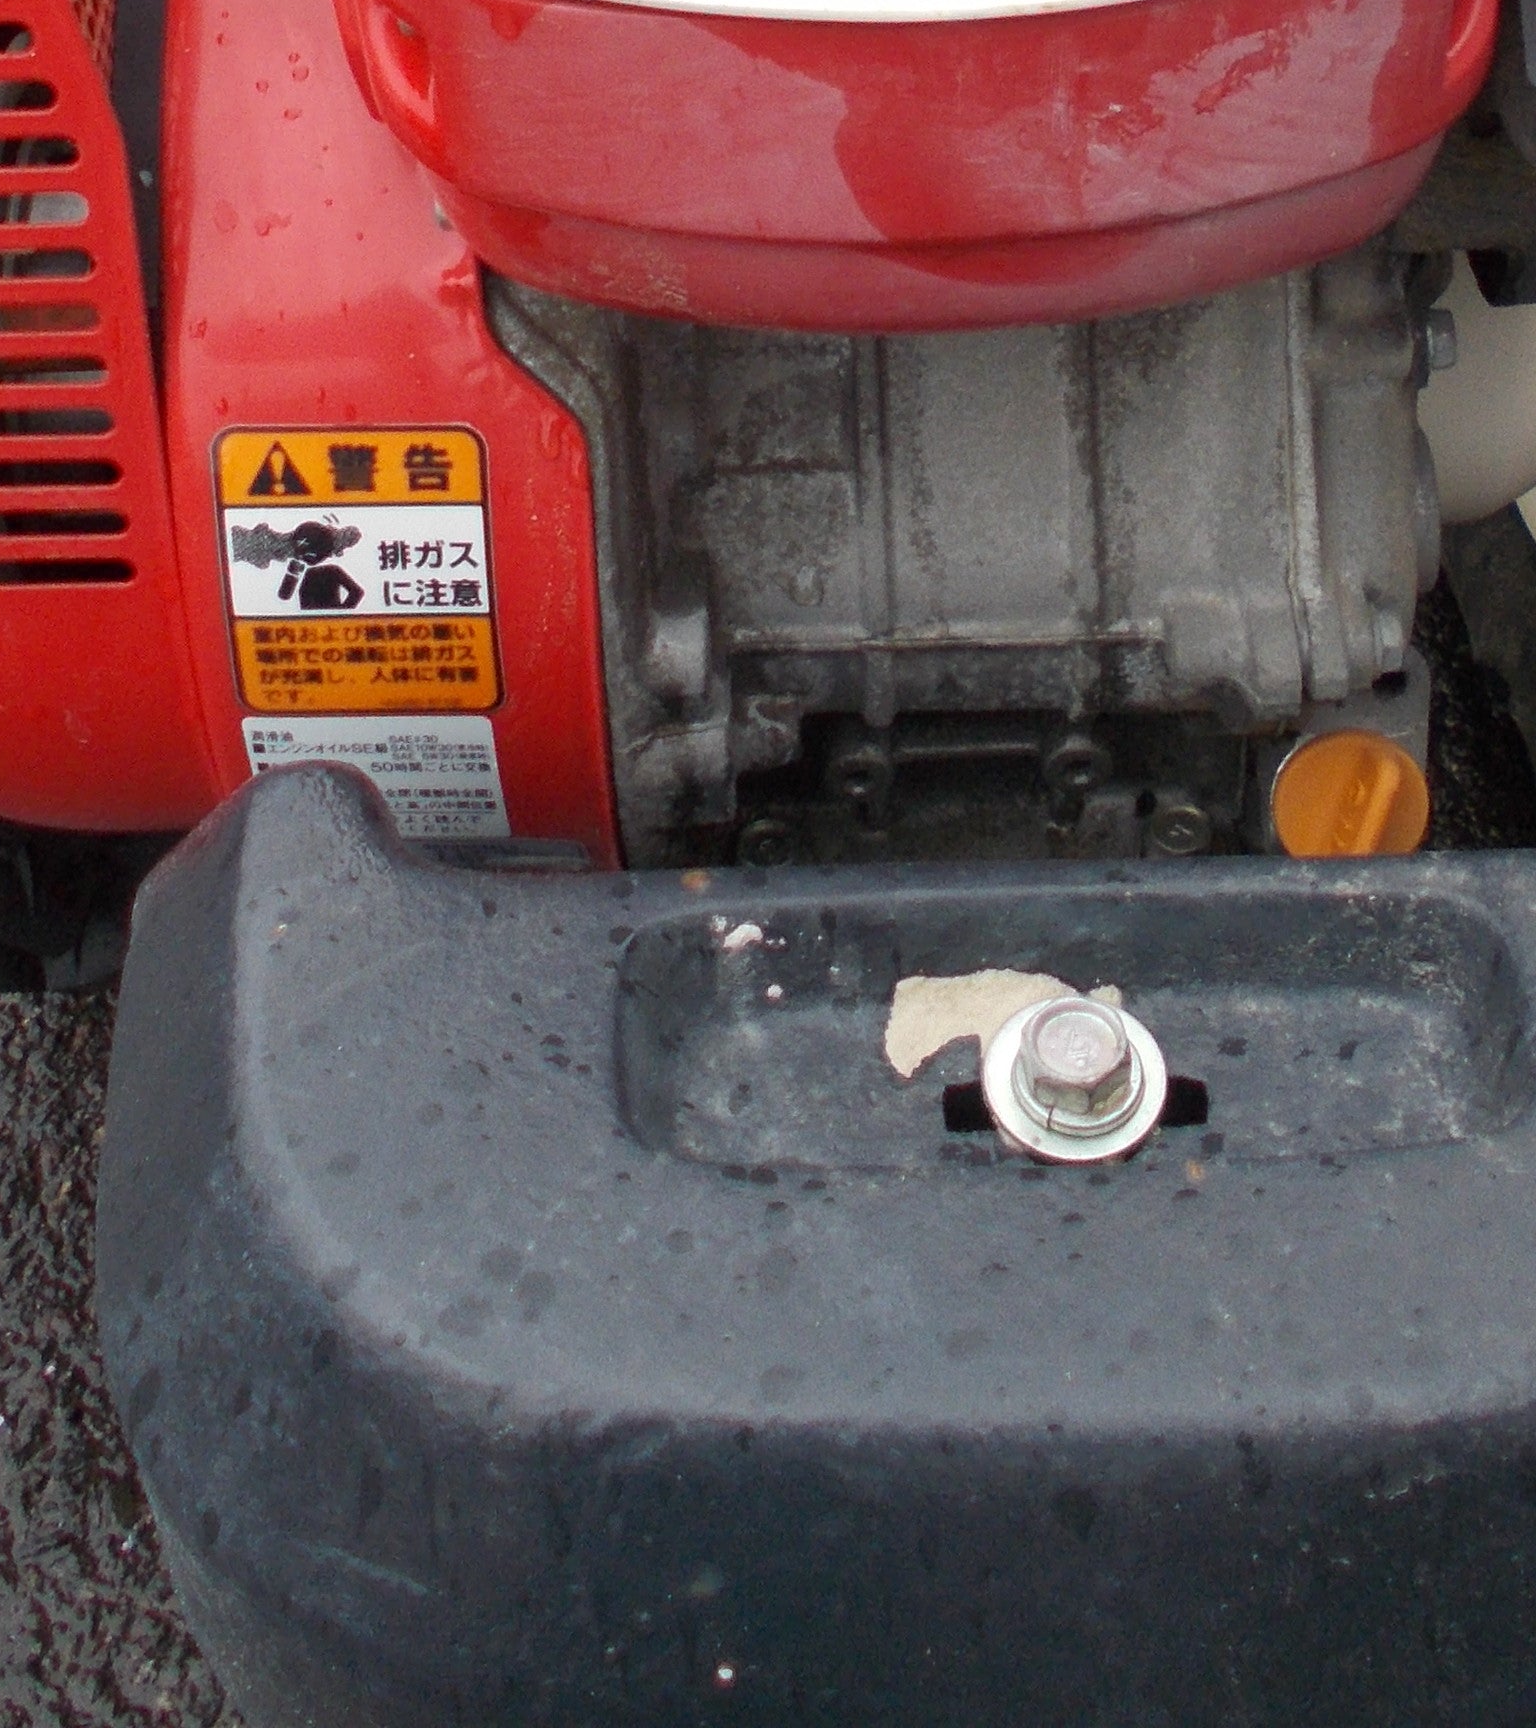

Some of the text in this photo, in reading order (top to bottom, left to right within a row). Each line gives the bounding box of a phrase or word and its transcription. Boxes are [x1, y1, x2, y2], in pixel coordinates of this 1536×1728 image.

[327, 442, 454, 493] 警告
[377, 538, 479, 570] 排ガス
[382, 577, 484, 609] に注意
